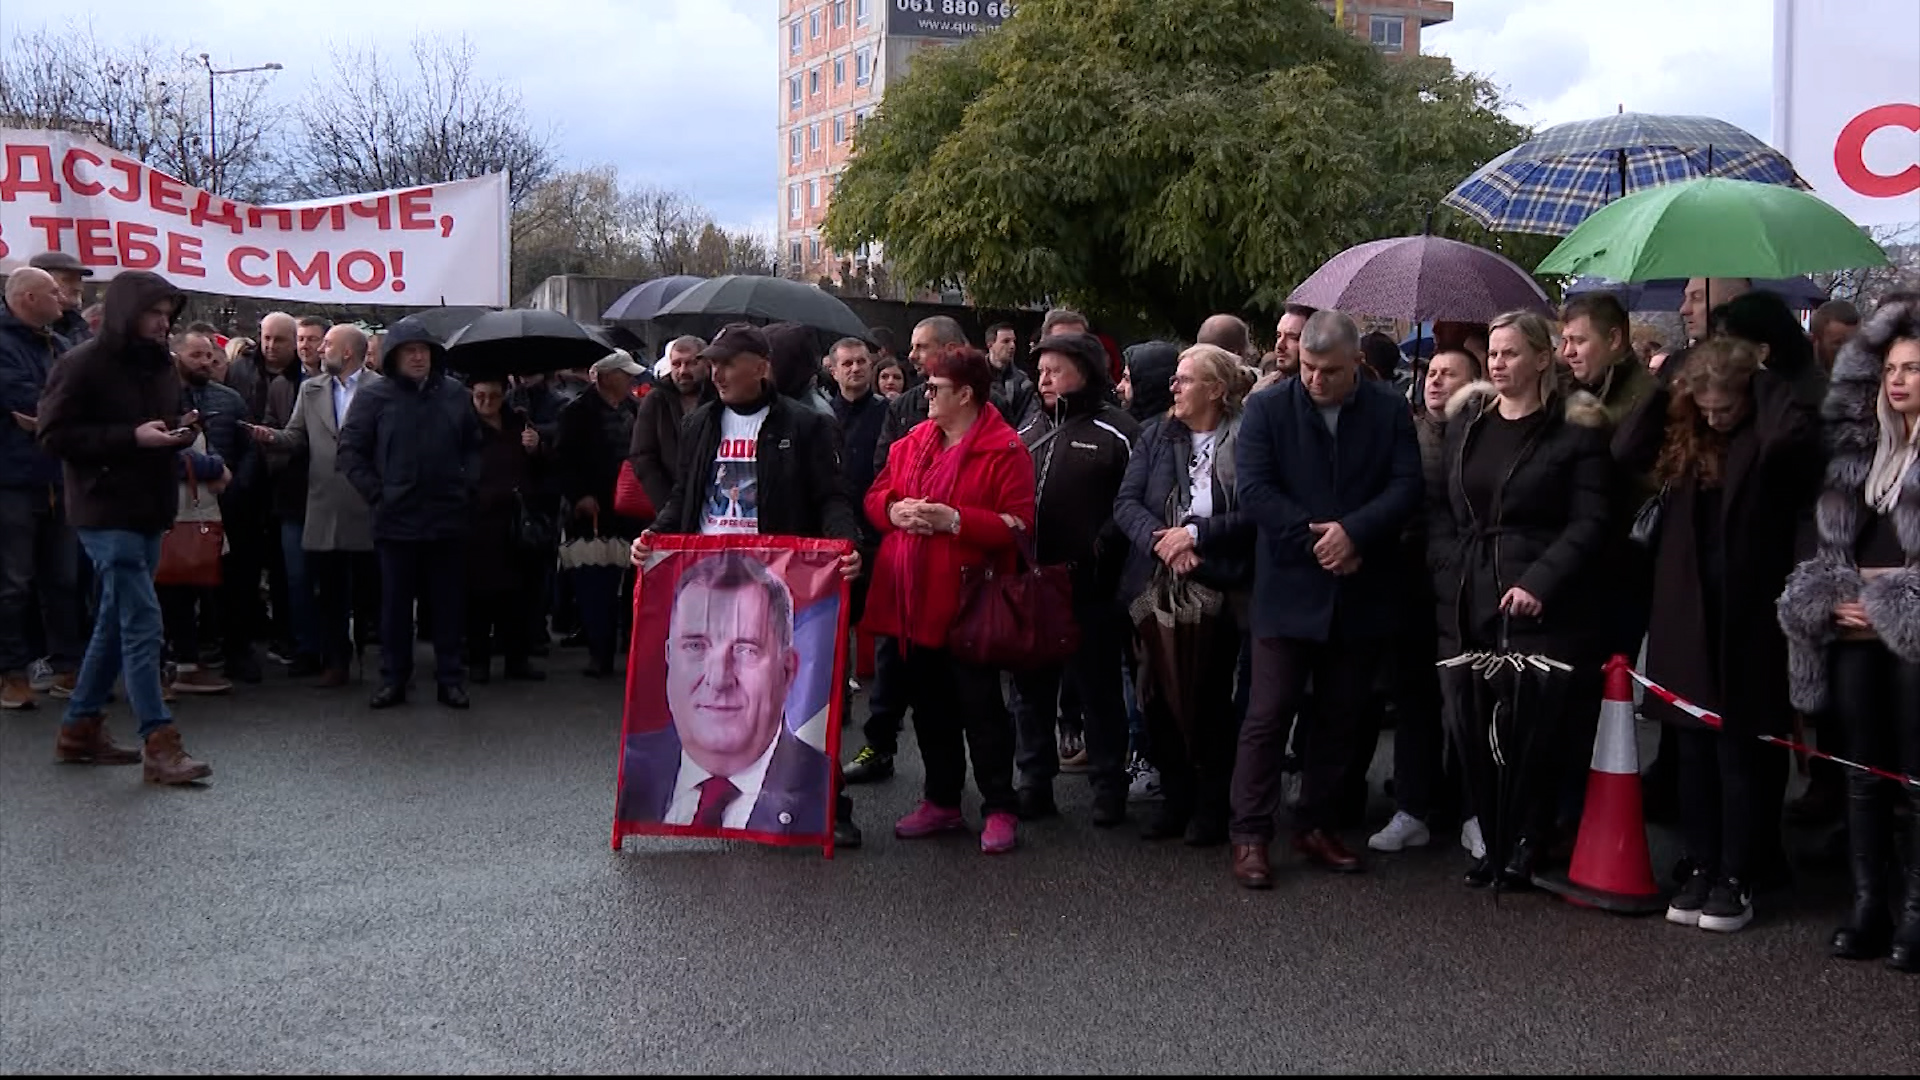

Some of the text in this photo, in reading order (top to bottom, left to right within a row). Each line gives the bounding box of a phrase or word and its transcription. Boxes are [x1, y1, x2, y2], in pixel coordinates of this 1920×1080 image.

[942, 0, 979, 16] 880
[30, 216, 206, 277] ТЕБЕ
[228, 247, 406, 292] СМО!
